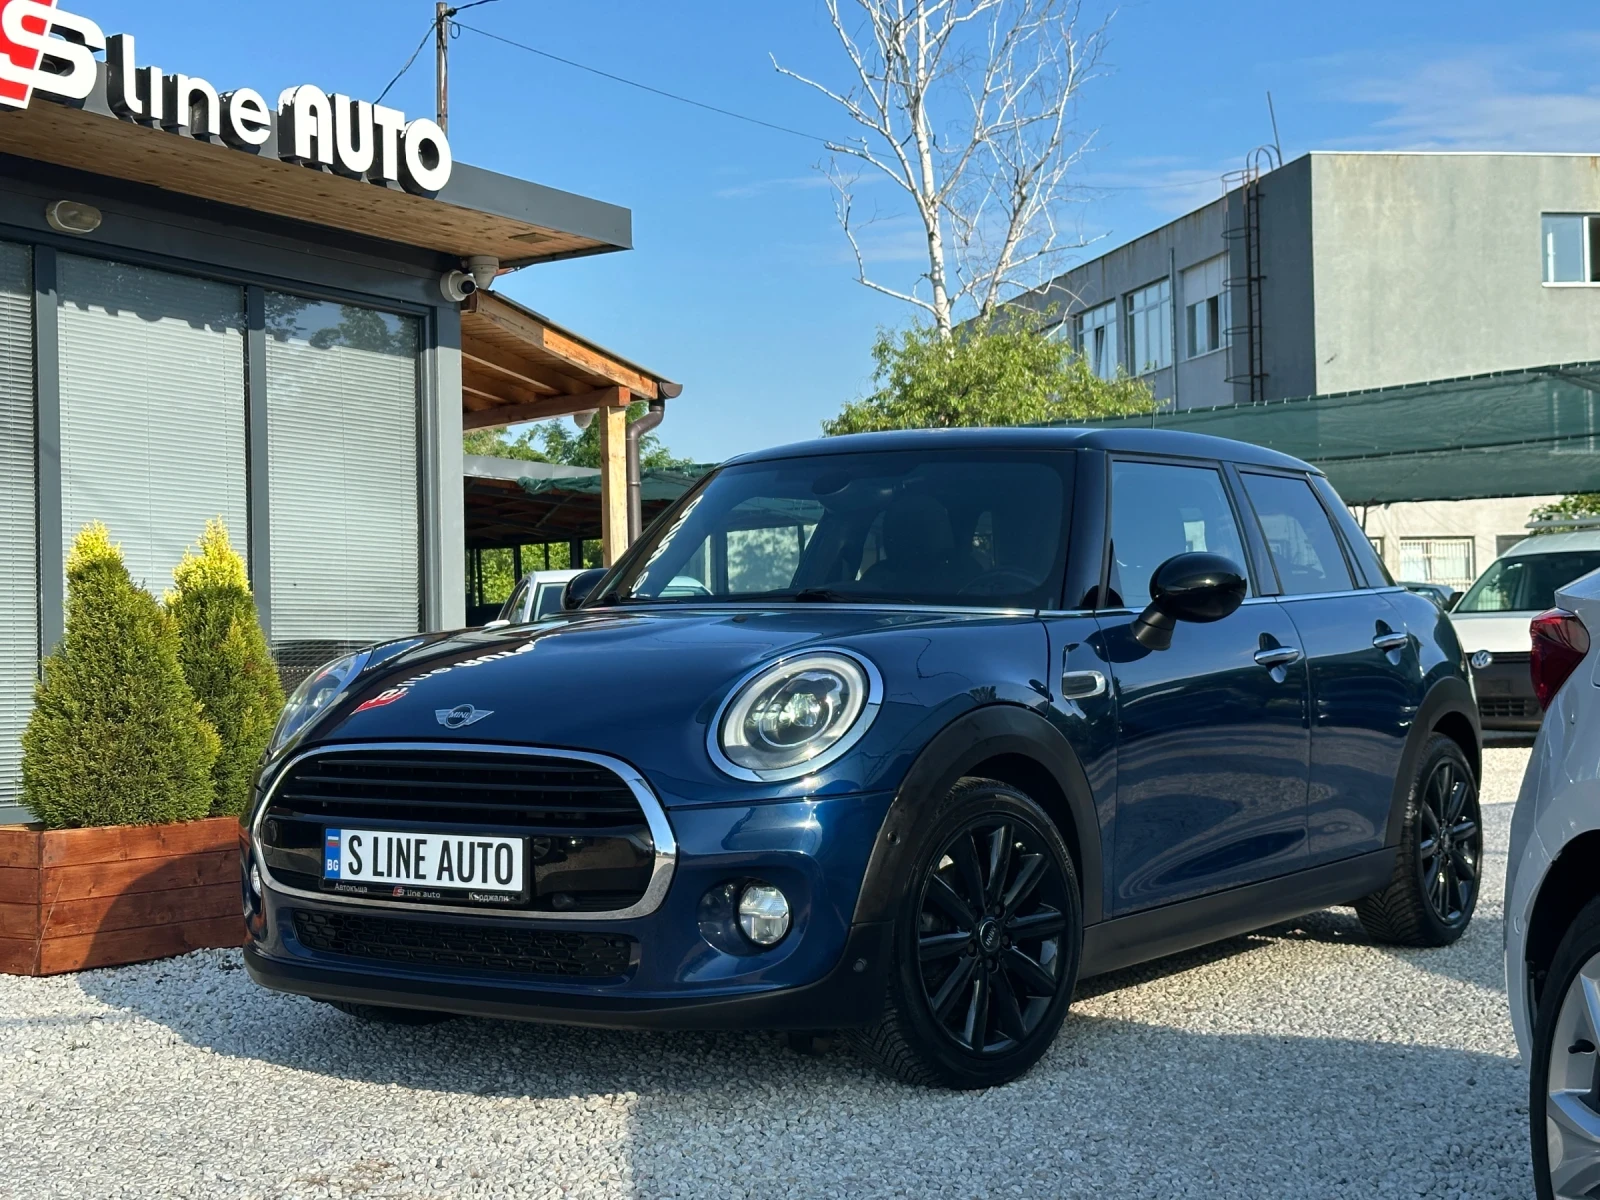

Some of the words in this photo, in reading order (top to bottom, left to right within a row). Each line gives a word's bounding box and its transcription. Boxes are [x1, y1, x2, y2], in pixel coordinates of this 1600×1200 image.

[0, 0, 106, 100] S
[294, 84, 452, 192] AUTO
[327, 859, 339, 871] BG
[348, 835, 363, 876] S
[372, 836, 428, 880] LINE
[436, 840, 514, 885] AUTO
[334, 883, 368, 894] Автокъща
